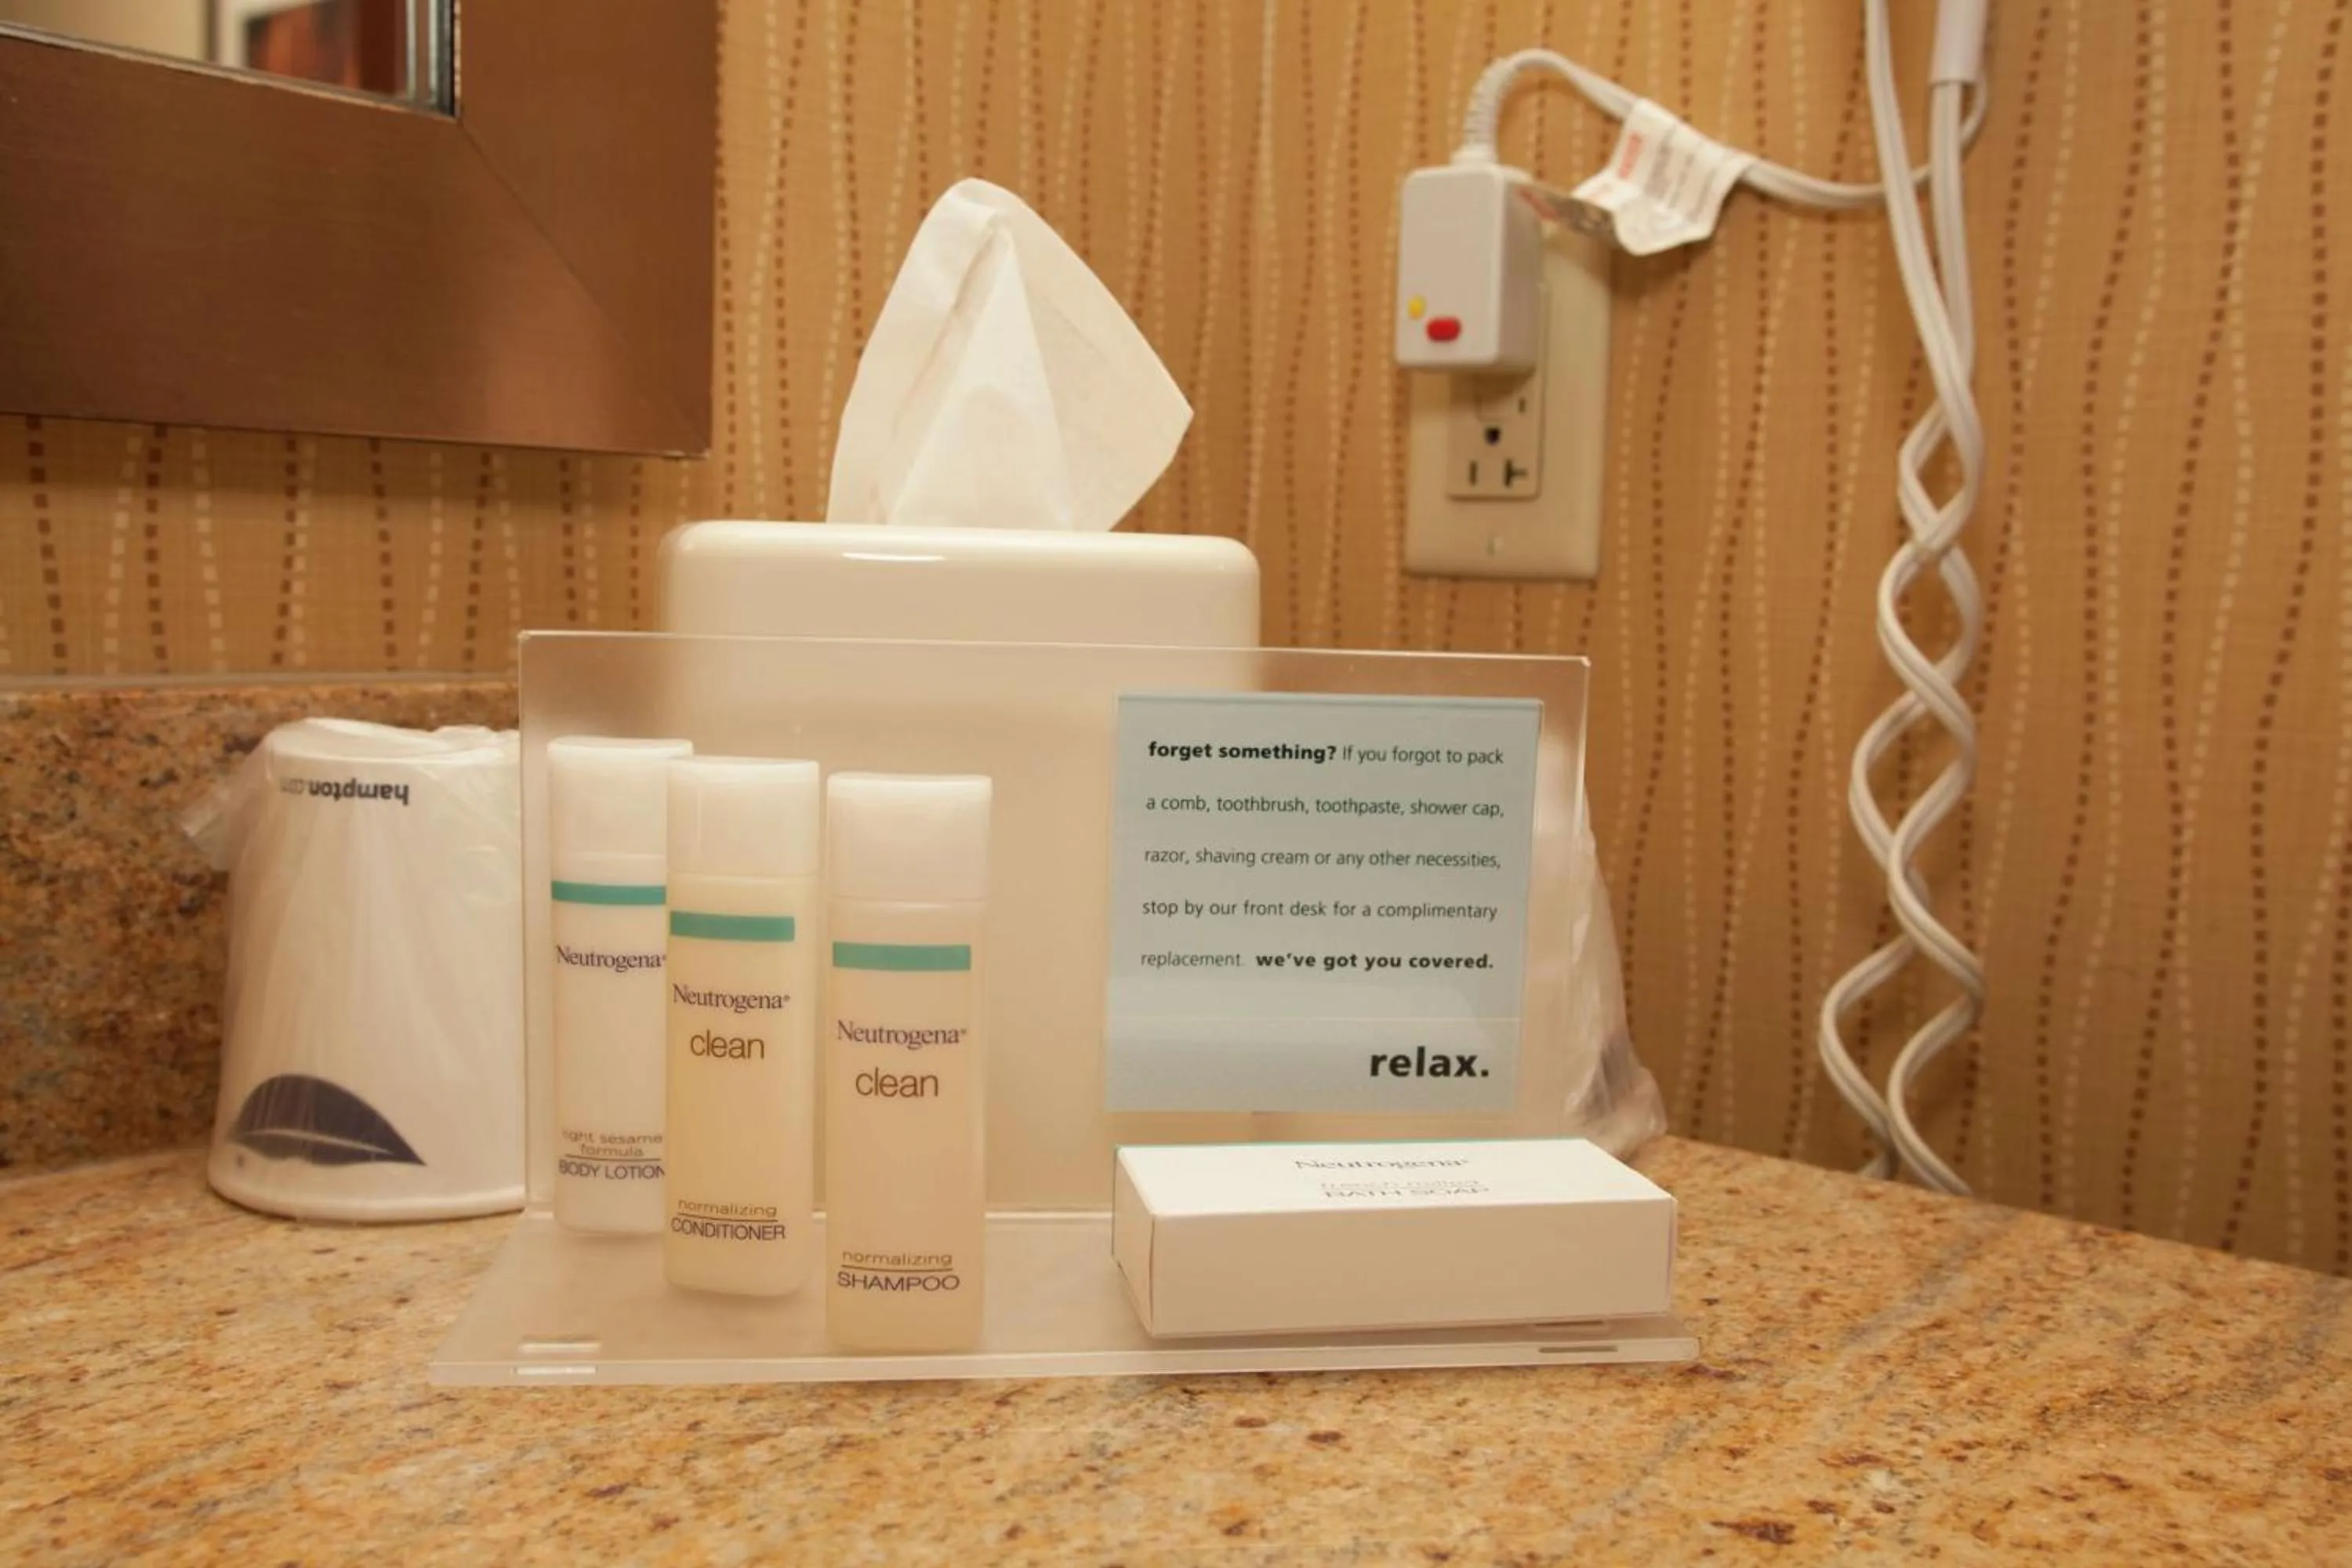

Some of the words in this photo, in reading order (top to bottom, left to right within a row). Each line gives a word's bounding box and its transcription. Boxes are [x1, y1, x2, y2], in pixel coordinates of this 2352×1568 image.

[1149, 741, 1213, 761] forget
[1218, 743, 1337, 764] something?
[1342, 746, 1354, 760] If
[1357, 749, 1387, 764] you
[1392, 746, 1440, 766] forgot
[1446, 749, 1462, 763] to
[1467, 748, 1504, 766] pack
[1146, 797, 1155, 810] a
[1161, 795, 1210, 813] comb,
[1217, 797, 1309, 814] toothbrush,
[1316, 799, 1405, 817] toothpaste,
[1410, 799, 1468, 815] shower
[1472, 803, 1504, 818] cap,
[1144, 849, 1189, 864] razor,
[1196, 848, 1255, 867] shaving
[1261, 851, 1308, 864] cream
[1315, 852, 1332, 865] or
[1336, 853, 1364, 869] any
[1369, 849, 1410, 866] other
[1415, 852, 1501, 869] necessities,
[1142, 901, 1178, 917] stop
[1185, 900, 1203, 918] by
[1209, 902, 1238, 915] our
[1244, 900, 1283, 916] front
[1290, 901, 1327, 916] desk
[1333, 901, 1356, 916] for
[1362, 905, 1371, 916] a
[1377, 902, 1498, 922] complimentary
[556, 944, 662, 973] Neutrogena
[1323, 954, 1357, 971] got
[1365, 956, 1402, 971] you
[1409, 953, 1494, 968] covered.
[673, 984, 784, 1013] Neutrogena
[690, 1029, 765, 1059] clean
[837, 1020, 960, 1050] Neutrogena
[1370, 1046, 1490, 1078] relax.
[855, 1067, 939, 1098] clean
[580, 1142, 644, 1156] formula
[599, 1133, 663, 1144] sesame
[558, 1159, 601, 1177] BODY
[677, 1199, 779, 1217] normalizing
[670, 1217, 786, 1241] CONDITIONER
[842, 1250, 953, 1267] normalizing
[837, 1271, 960, 1292] SHAMPOO
